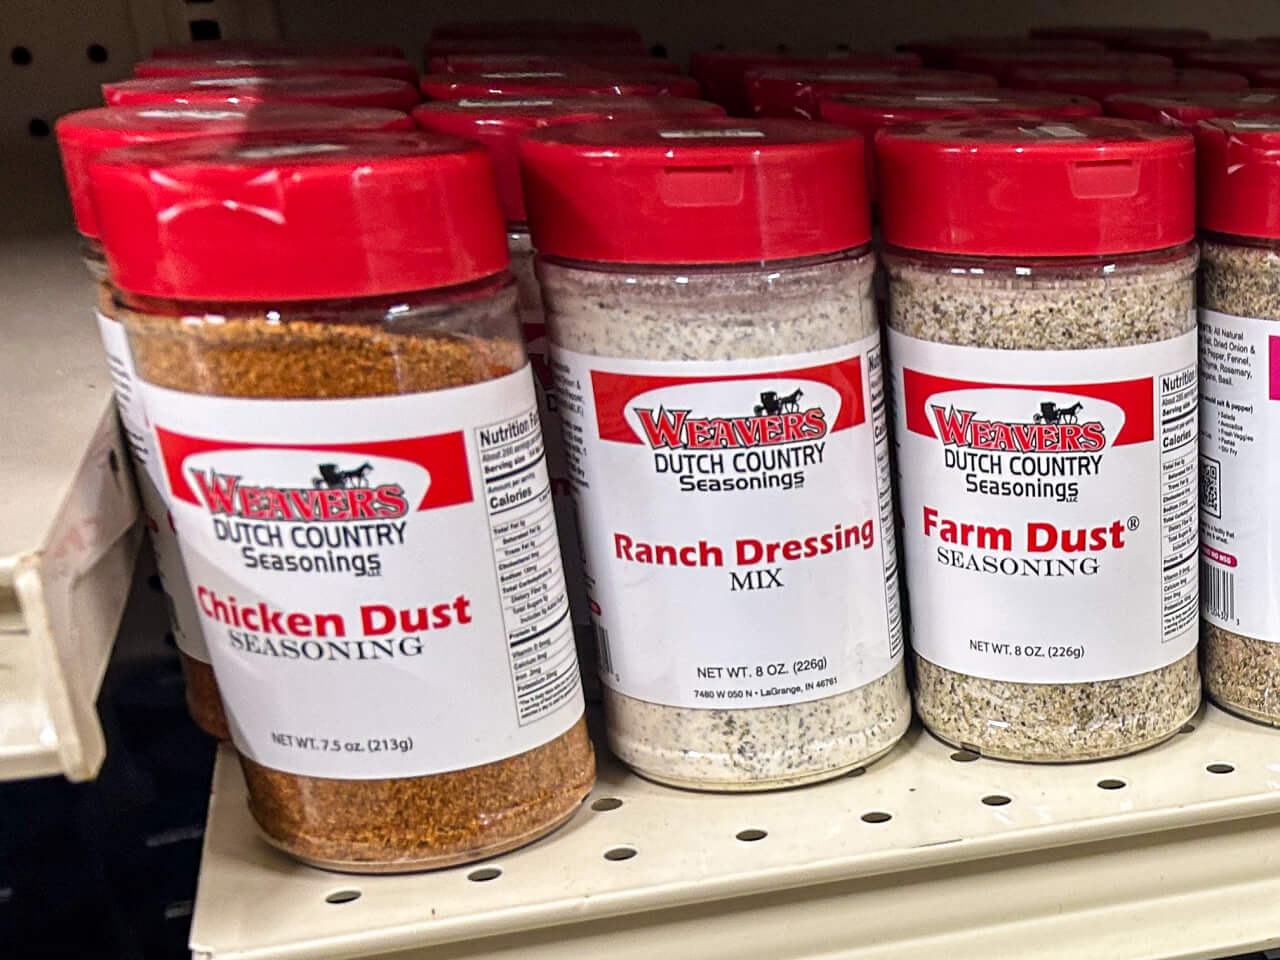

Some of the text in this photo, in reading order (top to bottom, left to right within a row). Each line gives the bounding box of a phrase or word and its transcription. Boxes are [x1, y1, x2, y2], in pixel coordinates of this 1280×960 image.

[1222, 329, 1244, 340] Natural
[1229, 342, 1248, 353] Onion
[480, 420, 528, 446] Nutrition
[635, 405, 828, 449] WEAVERS
[931, 405, 1105, 453] WEAVERS
[655, 443, 825, 474] DUTCH COUNTRY
[945, 449, 1103, 475] DUTCH COUNTRY
[680, 472, 804, 491] Seasonings
[966, 474, 1079, 502] Seasonings
[490, 487, 531, 508] Calories
[214, 519, 407, 548] DUTCH COUNTRY
[923, 506, 1012, 551] Farm
[614, 520, 874, 566] Ranch Dressing
[243, 547, 380, 577] Seasonings
[937, 546, 1099, 576] SEASONING
[730, 569, 784, 591] MIX
[198, 586, 471, 637] Chicken Dust
[229, 632, 423, 661] SEASONING
[970, 639, 1084, 659] NET WT. 8 OZ. (226g)
[697, 667, 723, 678] NET
[726, 666, 751, 678] WT.
[756, 665, 764, 676] 8
[793, 657, 827, 675] (226g)
[273, 733, 294, 747] NET
[321, 737, 341, 751] 7.5
[368, 735, 413, 752] (213g)
